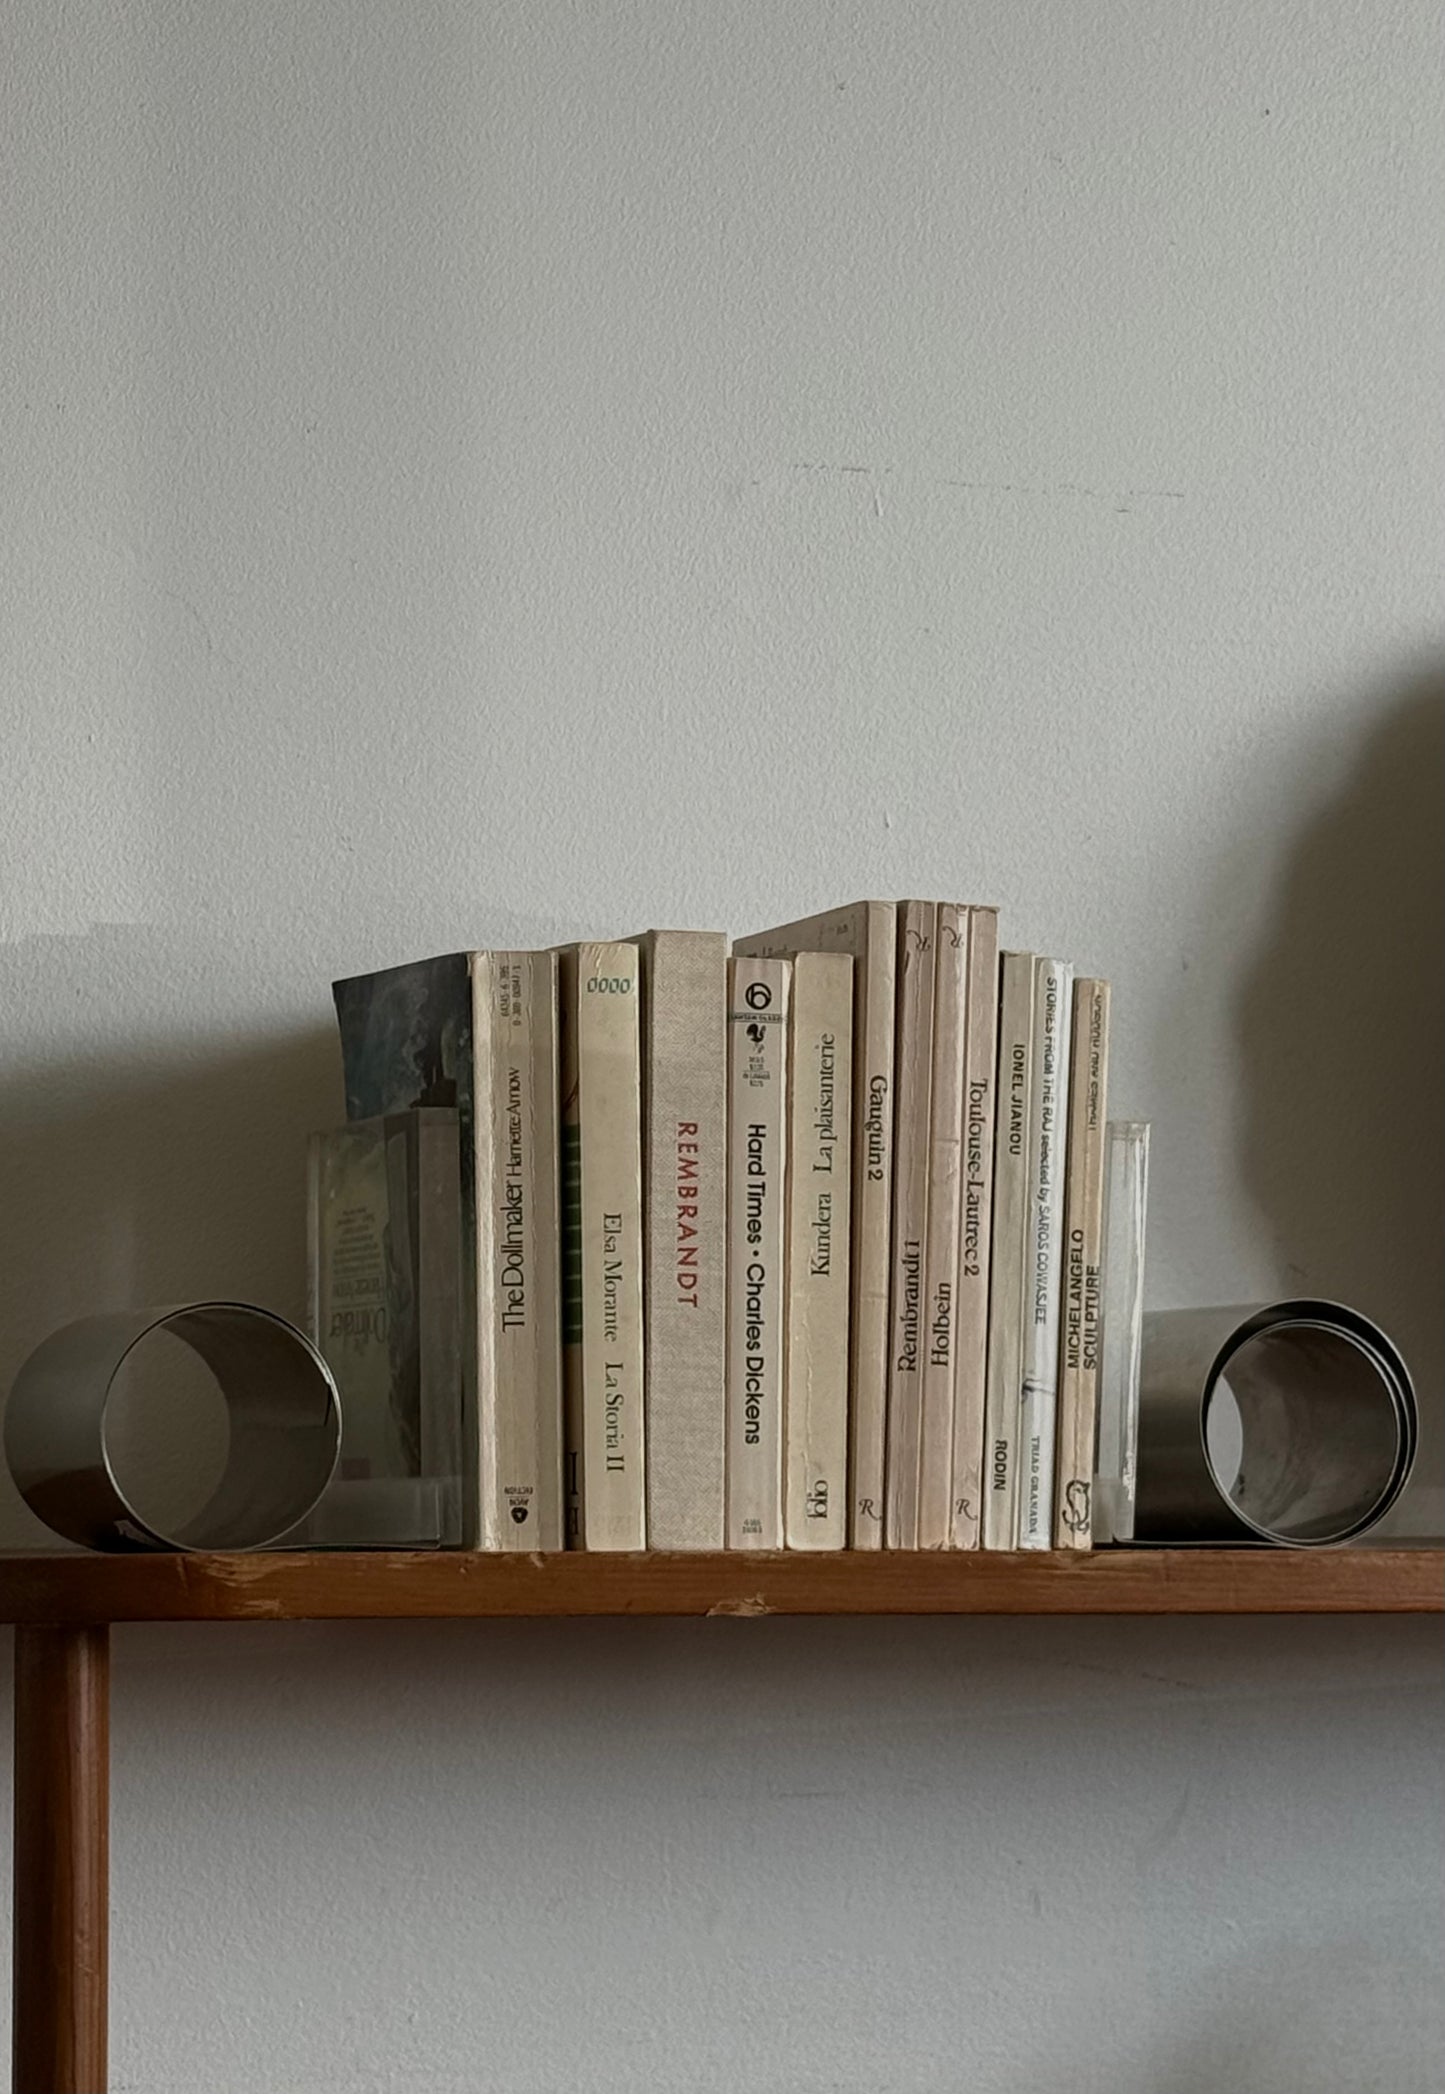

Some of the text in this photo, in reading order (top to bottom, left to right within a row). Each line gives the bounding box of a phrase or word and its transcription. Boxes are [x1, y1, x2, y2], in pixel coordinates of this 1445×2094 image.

[812, 1033, 837, 1174] La plaisanterie
[864, 1074, 888, 1182] Gauguin 2
[1009, 1044, 1026, 1156] IONEL JIANOU
[1035, 976, 1058, 1325] STORIES FROM THE RAJ selected by SAROS COWASJEE
[500, 1180, 524, 1287] Dollmaker
[677, 1121, 699, 1308] REMBRANDT
[810, 1193, 831, 1277] Kundera
[964, 1078, 988, 1277] Toulouse-Lautrec 2
[502, 1289, 525, 1333] The
[744, 1123, 767, 1445] Hard Times Charles Dickens
[897, 1252, 920, 1372] Rembrandt
[930, 1283, 951, 1367] Holbein
[1067, 1229, 1100, 1370] MICHELANGELO SCULPTURE
[602, 1213, 625, 1473] Elsa Morante La Storia II
[993, 1439, 1008, 1491] RODIN
[1028, 1435, 1041, 1535] TRIAD GRANADA
